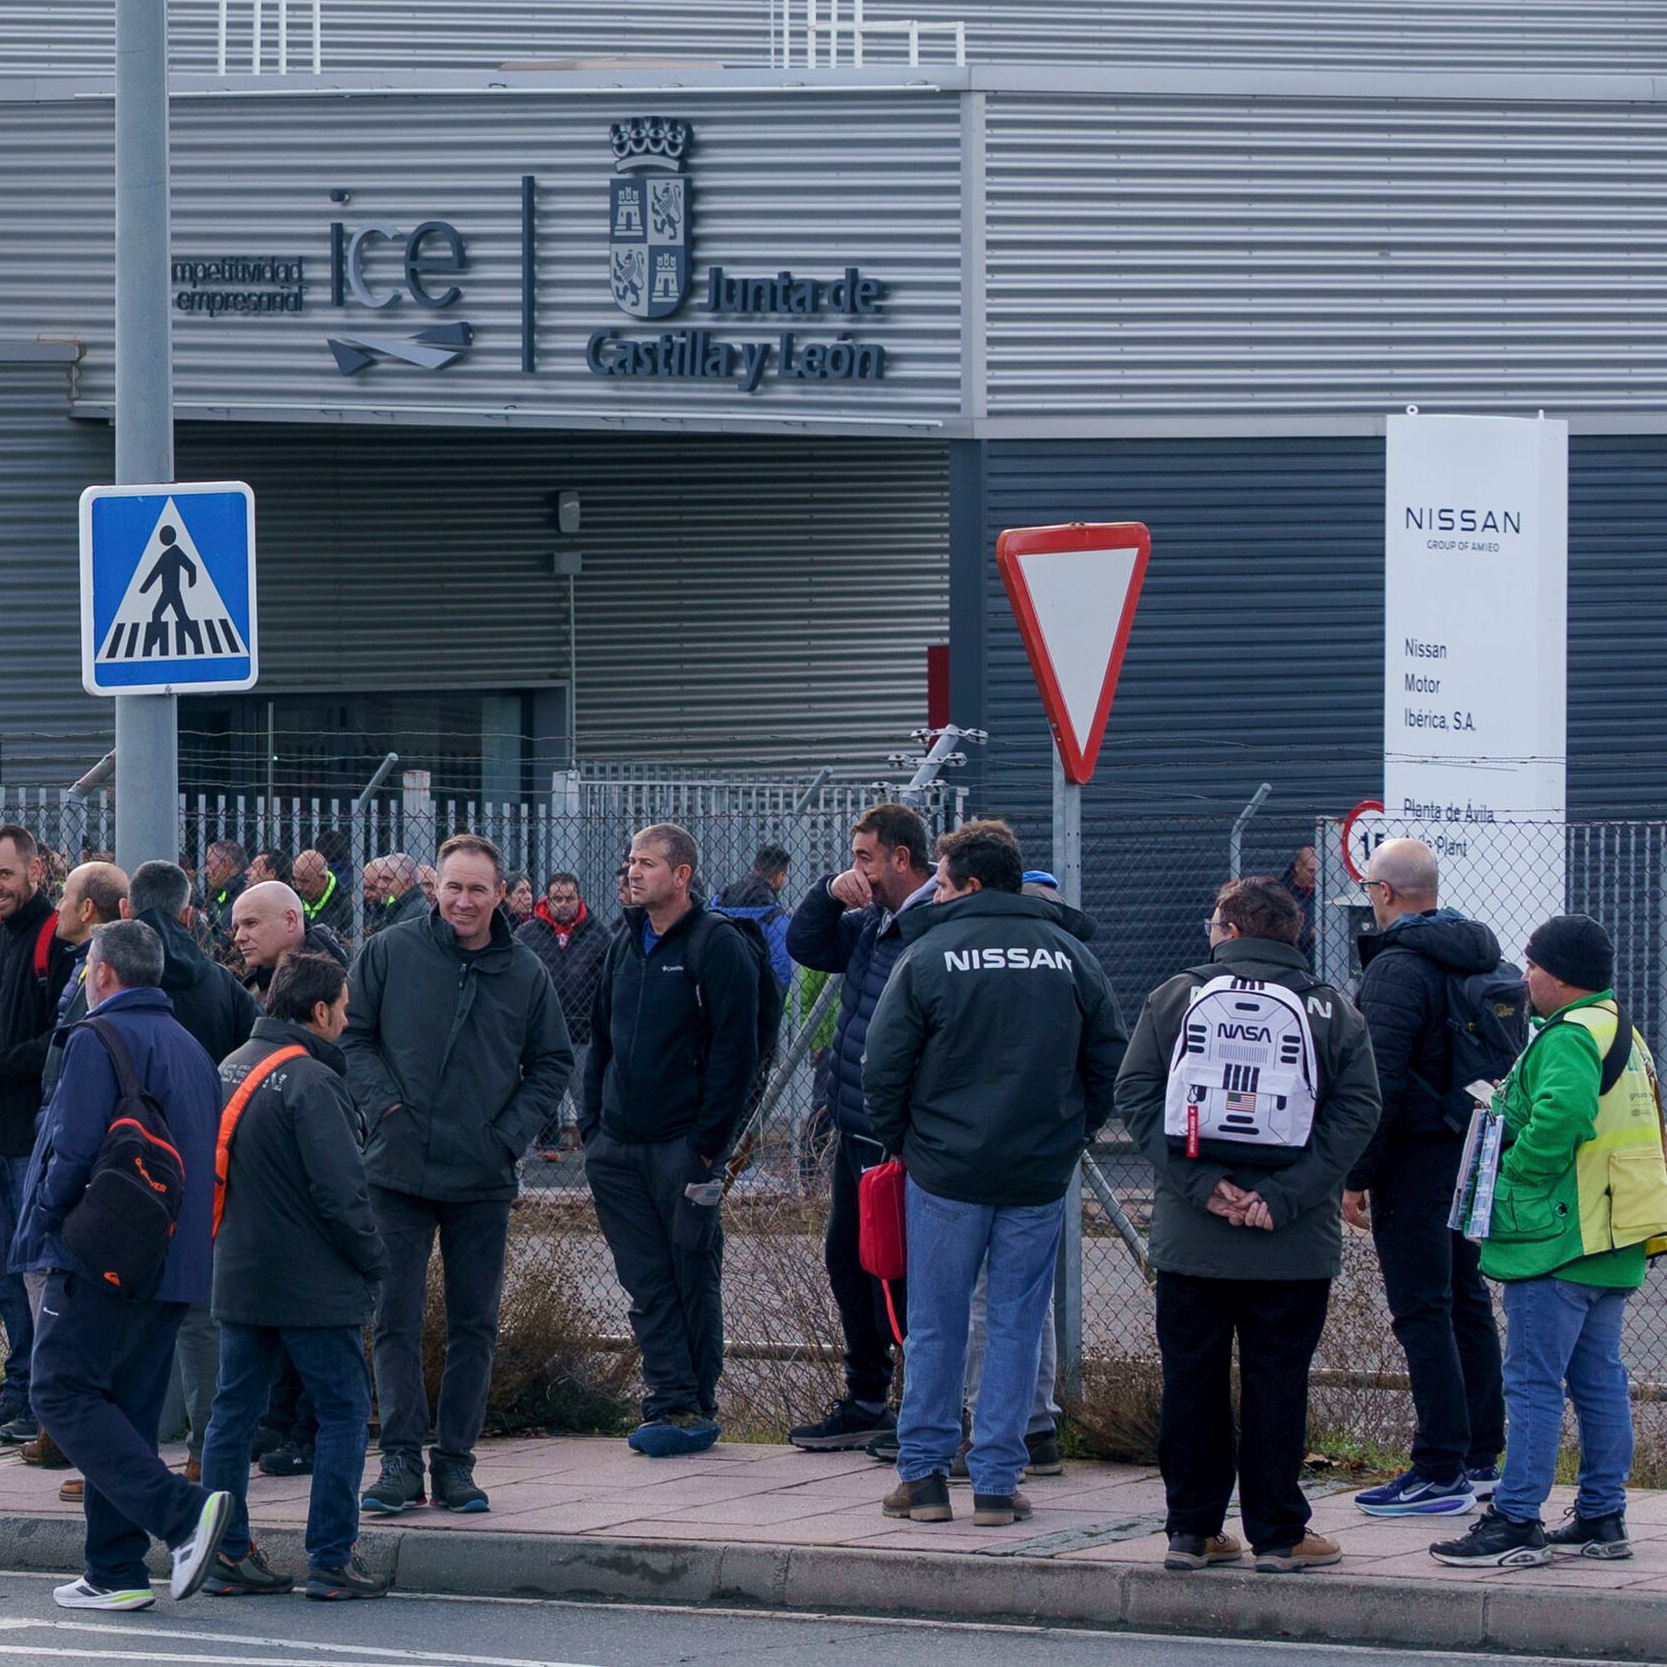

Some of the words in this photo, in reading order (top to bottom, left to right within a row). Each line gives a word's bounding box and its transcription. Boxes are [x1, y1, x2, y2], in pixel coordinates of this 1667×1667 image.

[330, 189, 466, 308] ice
[172, 256, 304, 288] mpetitividad
[697, 267, 817, 314] Junta
[827, 268, 883, 314] de
[587, 328, 734, 377] Castilla
[738, 342, 771, 392] y
[778, 332, 884, 380] León
[1405, 507, 1520, 534] NISSAN
[1427, 540, 1456, 551] GROUP
[1458, 541, 1469, 551] OF
[1405, 638, 1447, 658] Nissan
[1405, 673, 1440, 693] Motor
[1405, 708, 1449, 732] Ibérica,
[1453, 711, 1476, 731] S.A.
[1404, 798, 1441, 819] Planta
[1446, 802, 1461, 821] de
[1466, 799, 1494, 822] Ávila
[1437, 836, 1467, 857] Plant
[944, 947, 1073, 973] NISSAN
[1218, 1022, 1272, 1044] NASA
